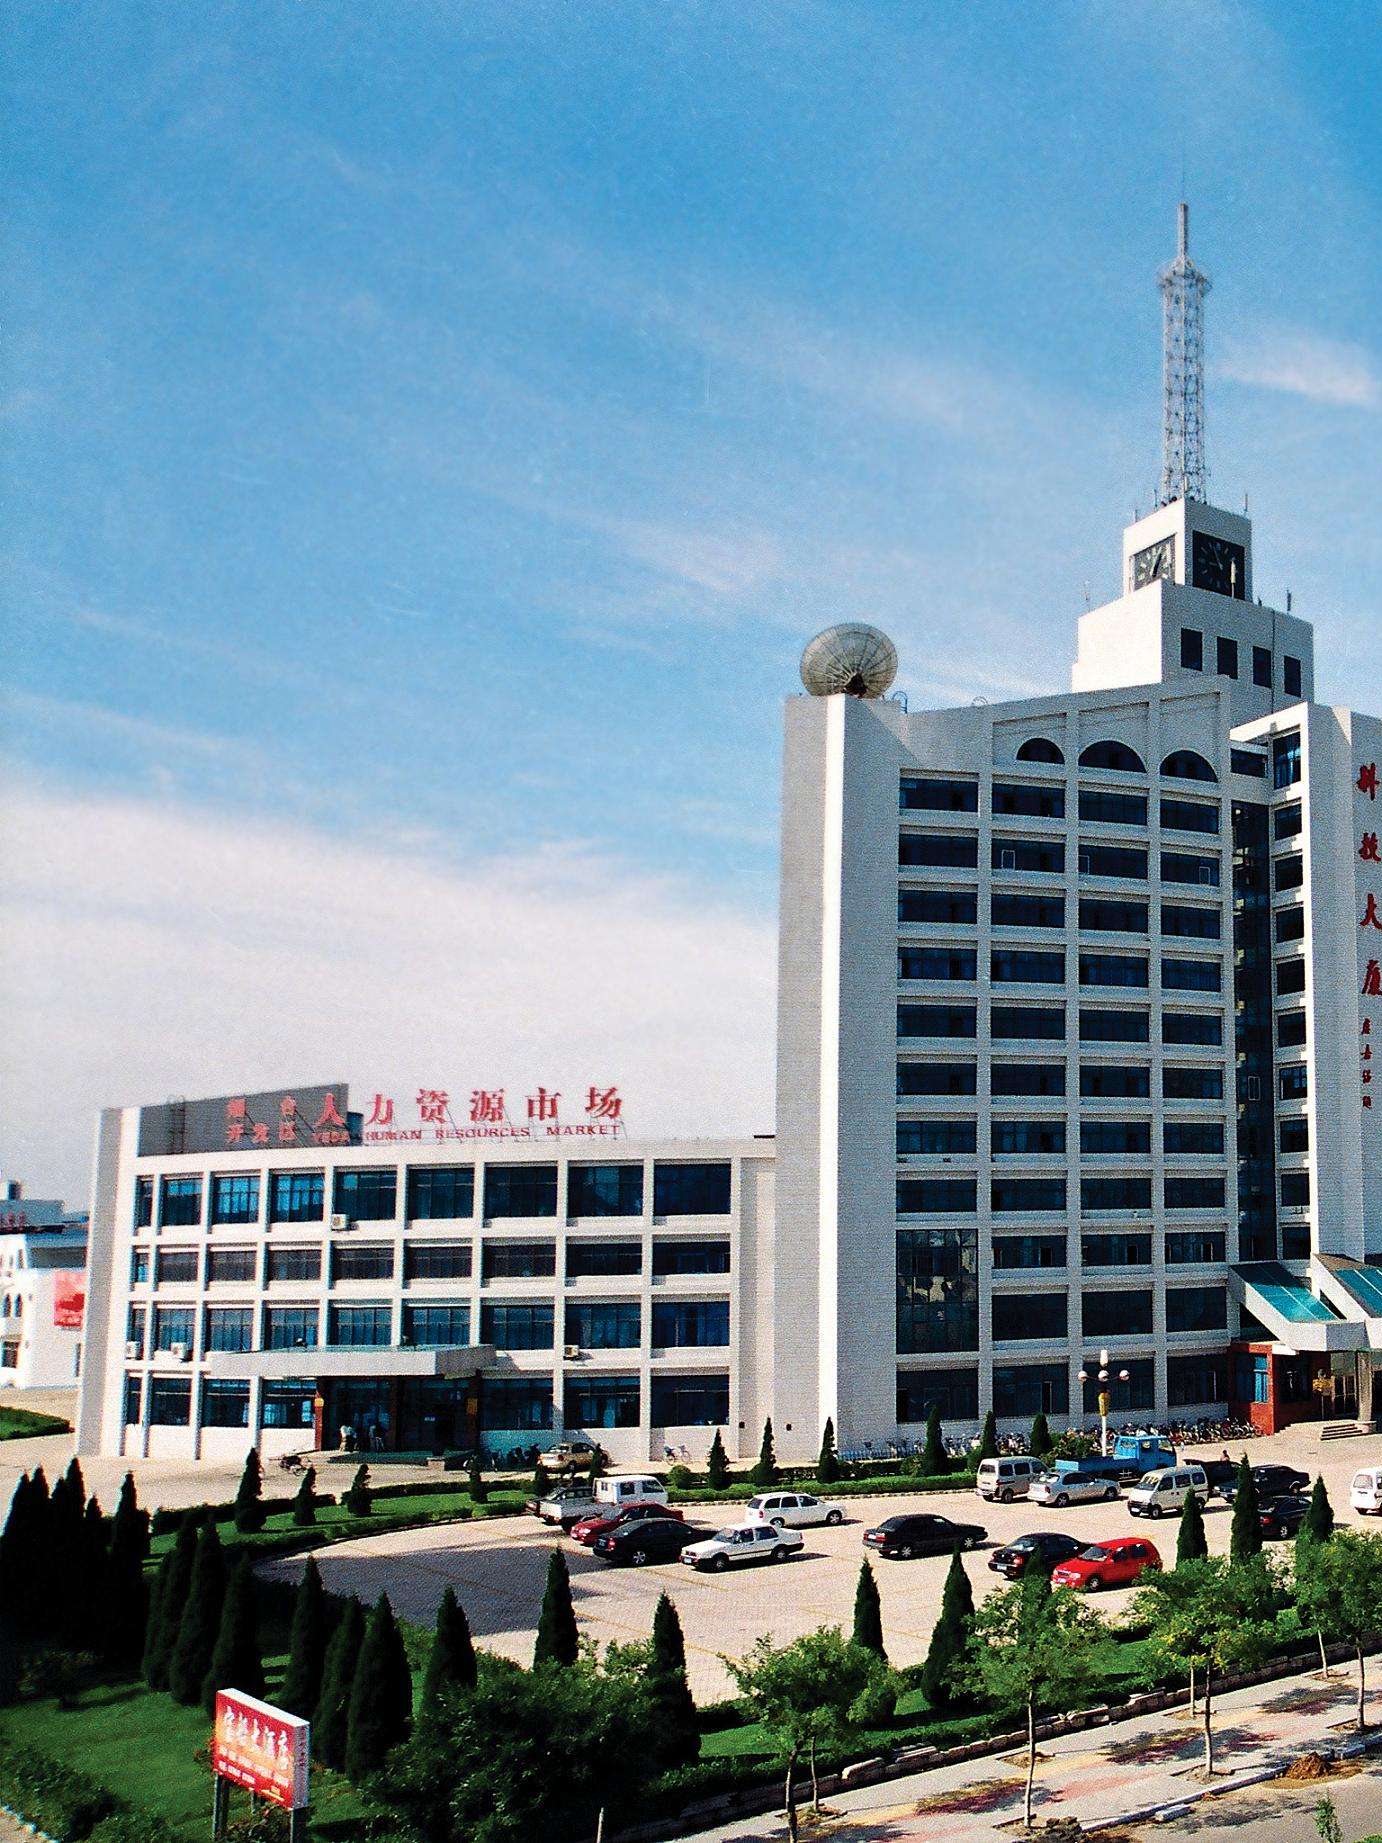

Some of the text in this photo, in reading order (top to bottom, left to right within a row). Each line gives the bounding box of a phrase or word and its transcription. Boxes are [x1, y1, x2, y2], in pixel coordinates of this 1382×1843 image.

[365, 1128, 422, 1141] HUMAN
[435, 1125, 530, 1139] RESOURCES
[546, 1123, 621, 1136] MARKET
